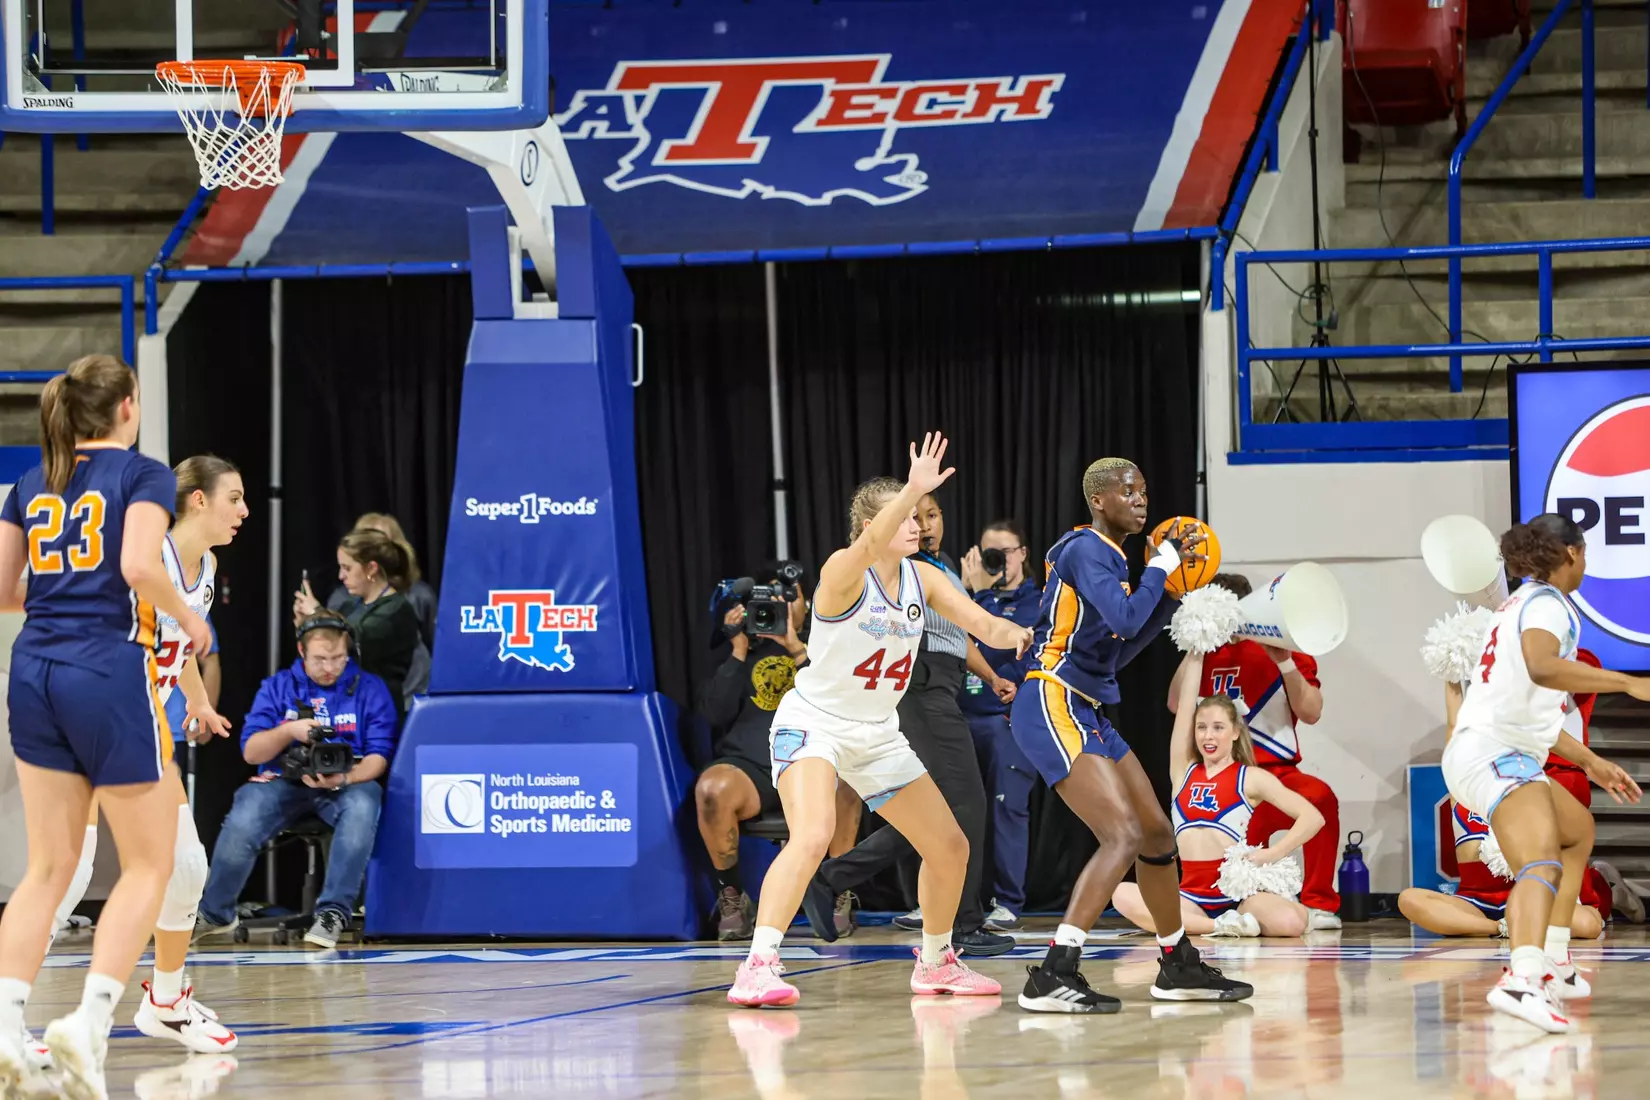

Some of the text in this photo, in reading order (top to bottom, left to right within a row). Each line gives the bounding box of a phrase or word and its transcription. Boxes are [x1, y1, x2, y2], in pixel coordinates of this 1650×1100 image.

[22, 96, 74, 109] SPALDING
[465, 497, 521, 520] Super
[537, 496, 598, 515] Foods
[26, 490, 107, 575] 23
[852, 648, 912, 691] 44
[490, 773, 580, 787] North Louisiana
[490, 790, 616, 814] Orthopaedic &
[490, 814, 632, 838] Sports Medicine
